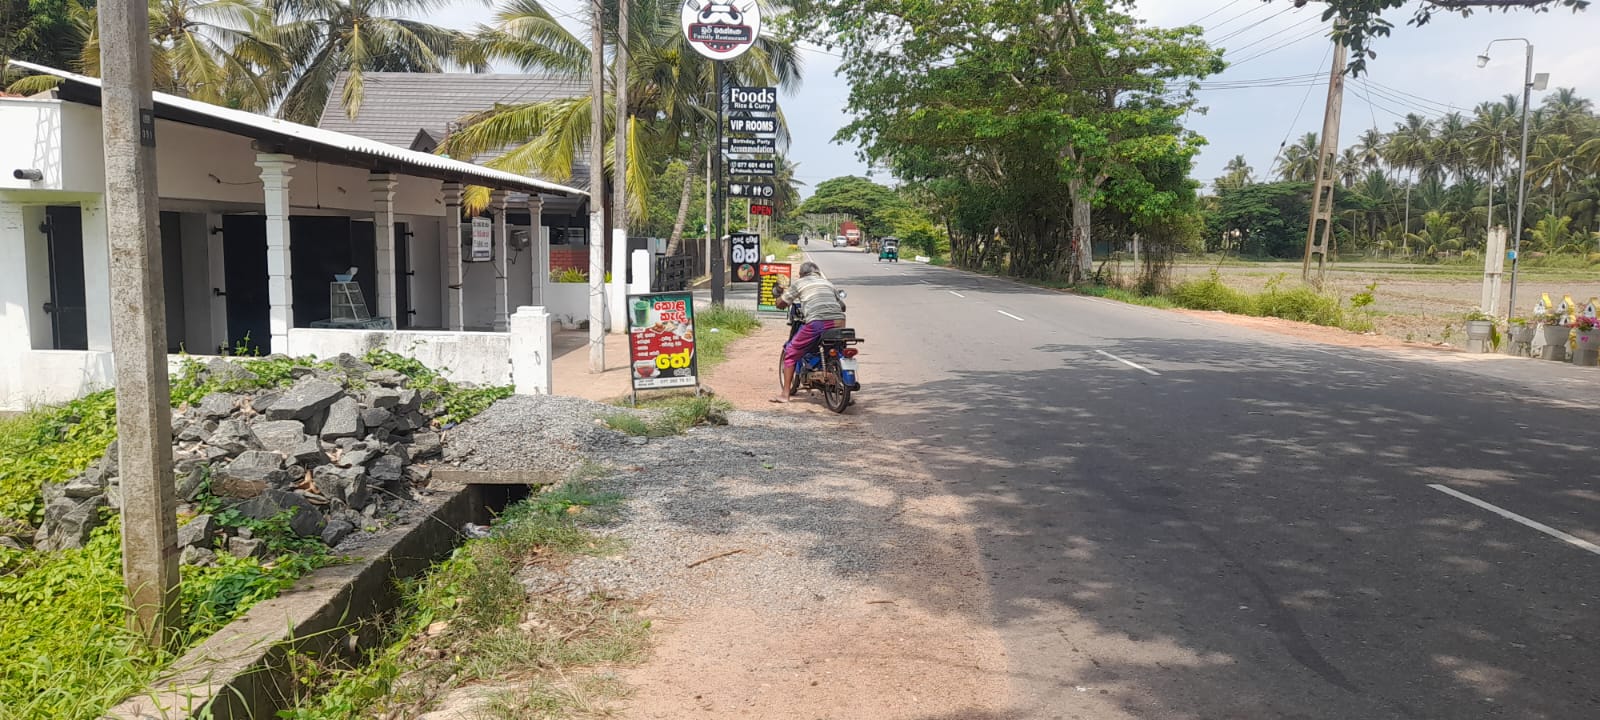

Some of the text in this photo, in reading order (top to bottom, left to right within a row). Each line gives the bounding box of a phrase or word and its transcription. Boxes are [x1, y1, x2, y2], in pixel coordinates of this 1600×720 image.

[693, 32, 714, 41] Family
[731, 88, 774, 103] Foods
[754, 103, 771, 111] Curry
[730, 120, 774, 131] VIP ROOMS
[730, 145, 774, 153] Accommodation
[751, 205, 772, 216] OPEN
[732, 244, 759, 264] බත්
[654, 301, 685, 311] කොළ
[660, 312, 687, 323] කැඳ
[656, 348, 690, 369] තේ
